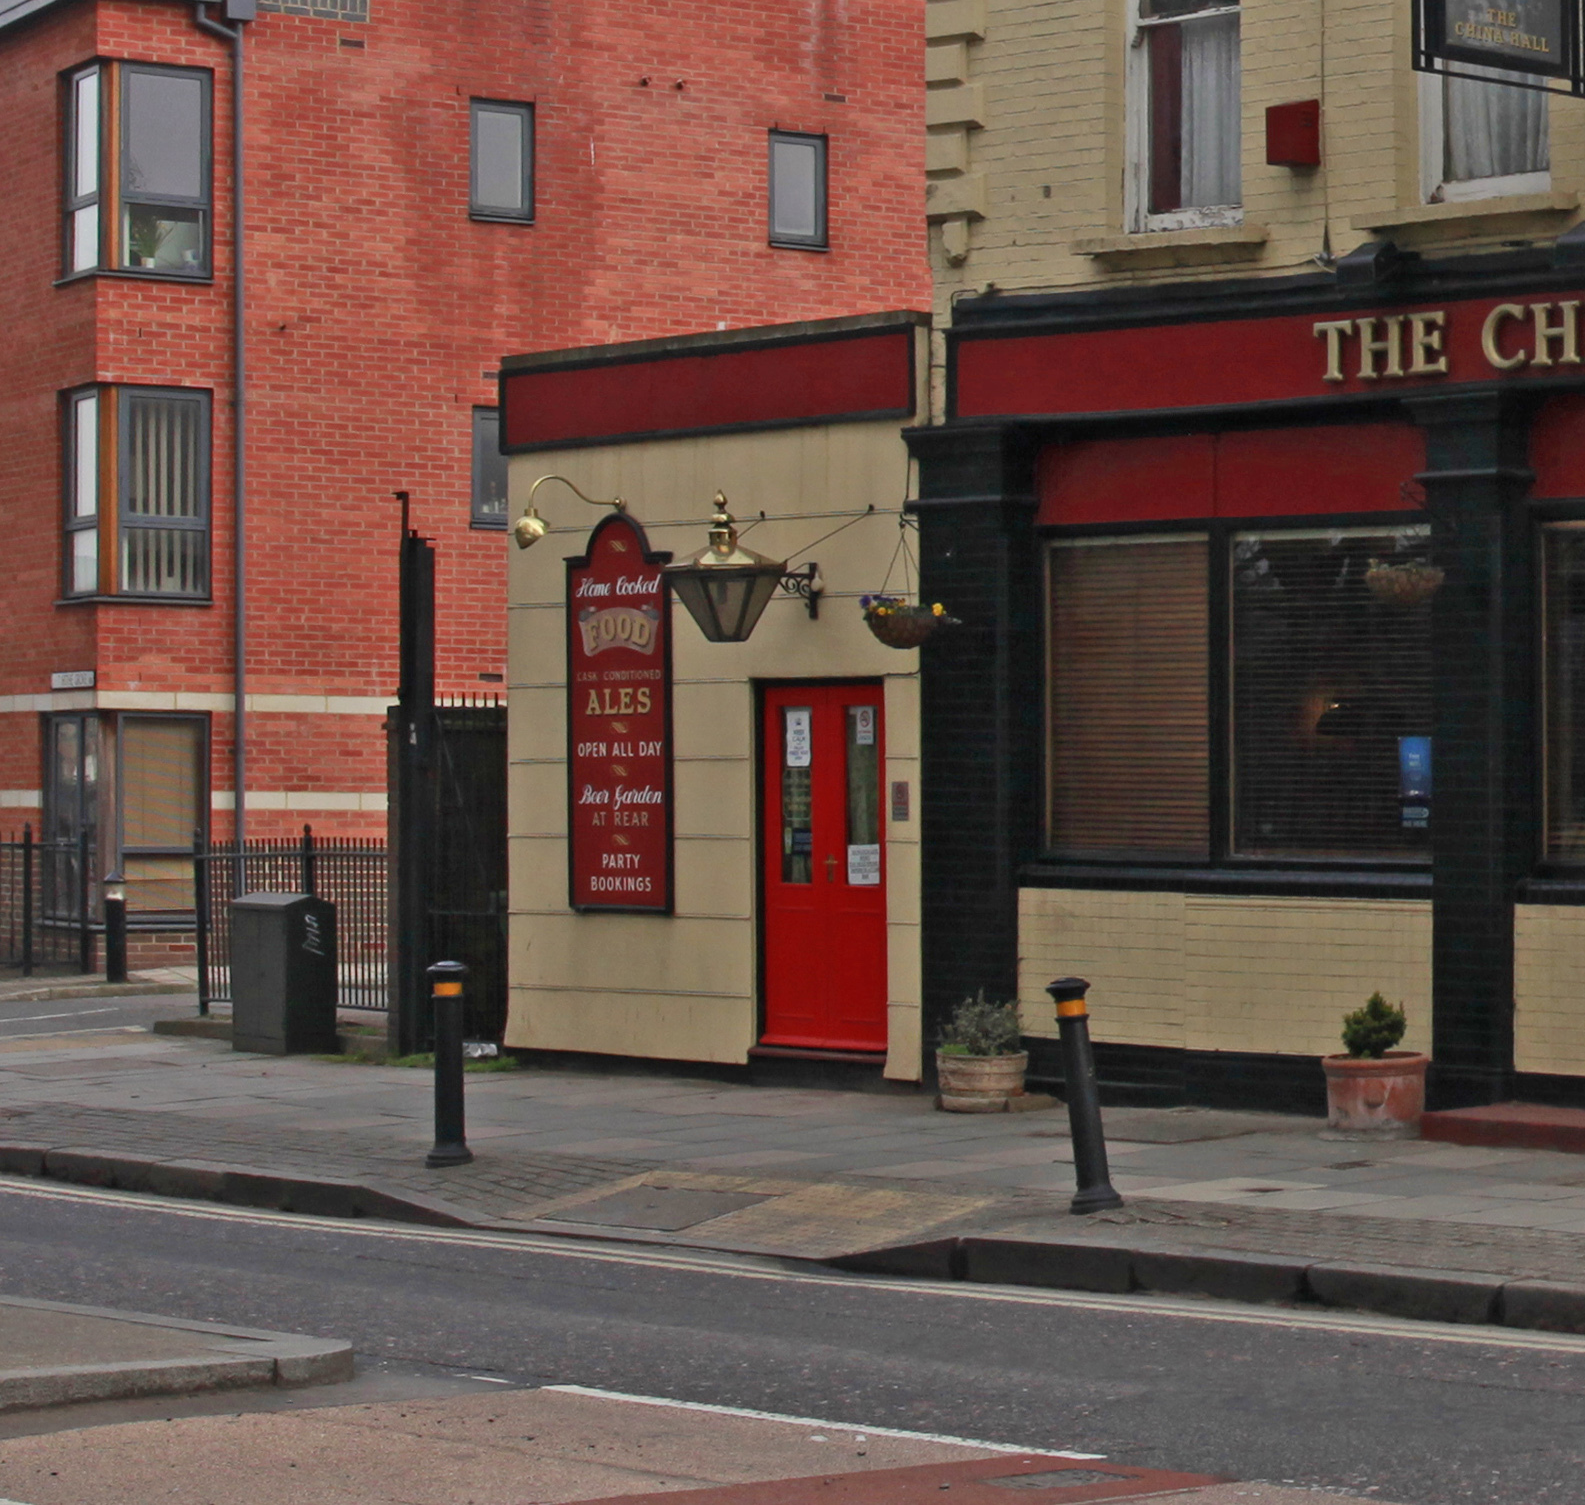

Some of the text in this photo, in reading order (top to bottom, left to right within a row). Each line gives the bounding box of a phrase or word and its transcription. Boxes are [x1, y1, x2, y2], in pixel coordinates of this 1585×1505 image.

[1487, 8, 1517, 27] THE
[1455, 21, 1550, 53] CHINA HALL
[1313, 310, 1449, 382] THE
[576, 574, 661, 597] Home Cooked
[585, 613, 651, 650] FOOD
[577, 669, 661, 682] CASK CONDITIONED
[586, 687, 651, 716] ALES
[578, 741, 662, 757] OPEN ALL DAY
[578, 784, 662, 810] Beer Garden
[592, 811, 649, 827] AT REAR
[602, 853, 641, 869] PARTY
[590, 876, 652, 892] BOOKINGS
